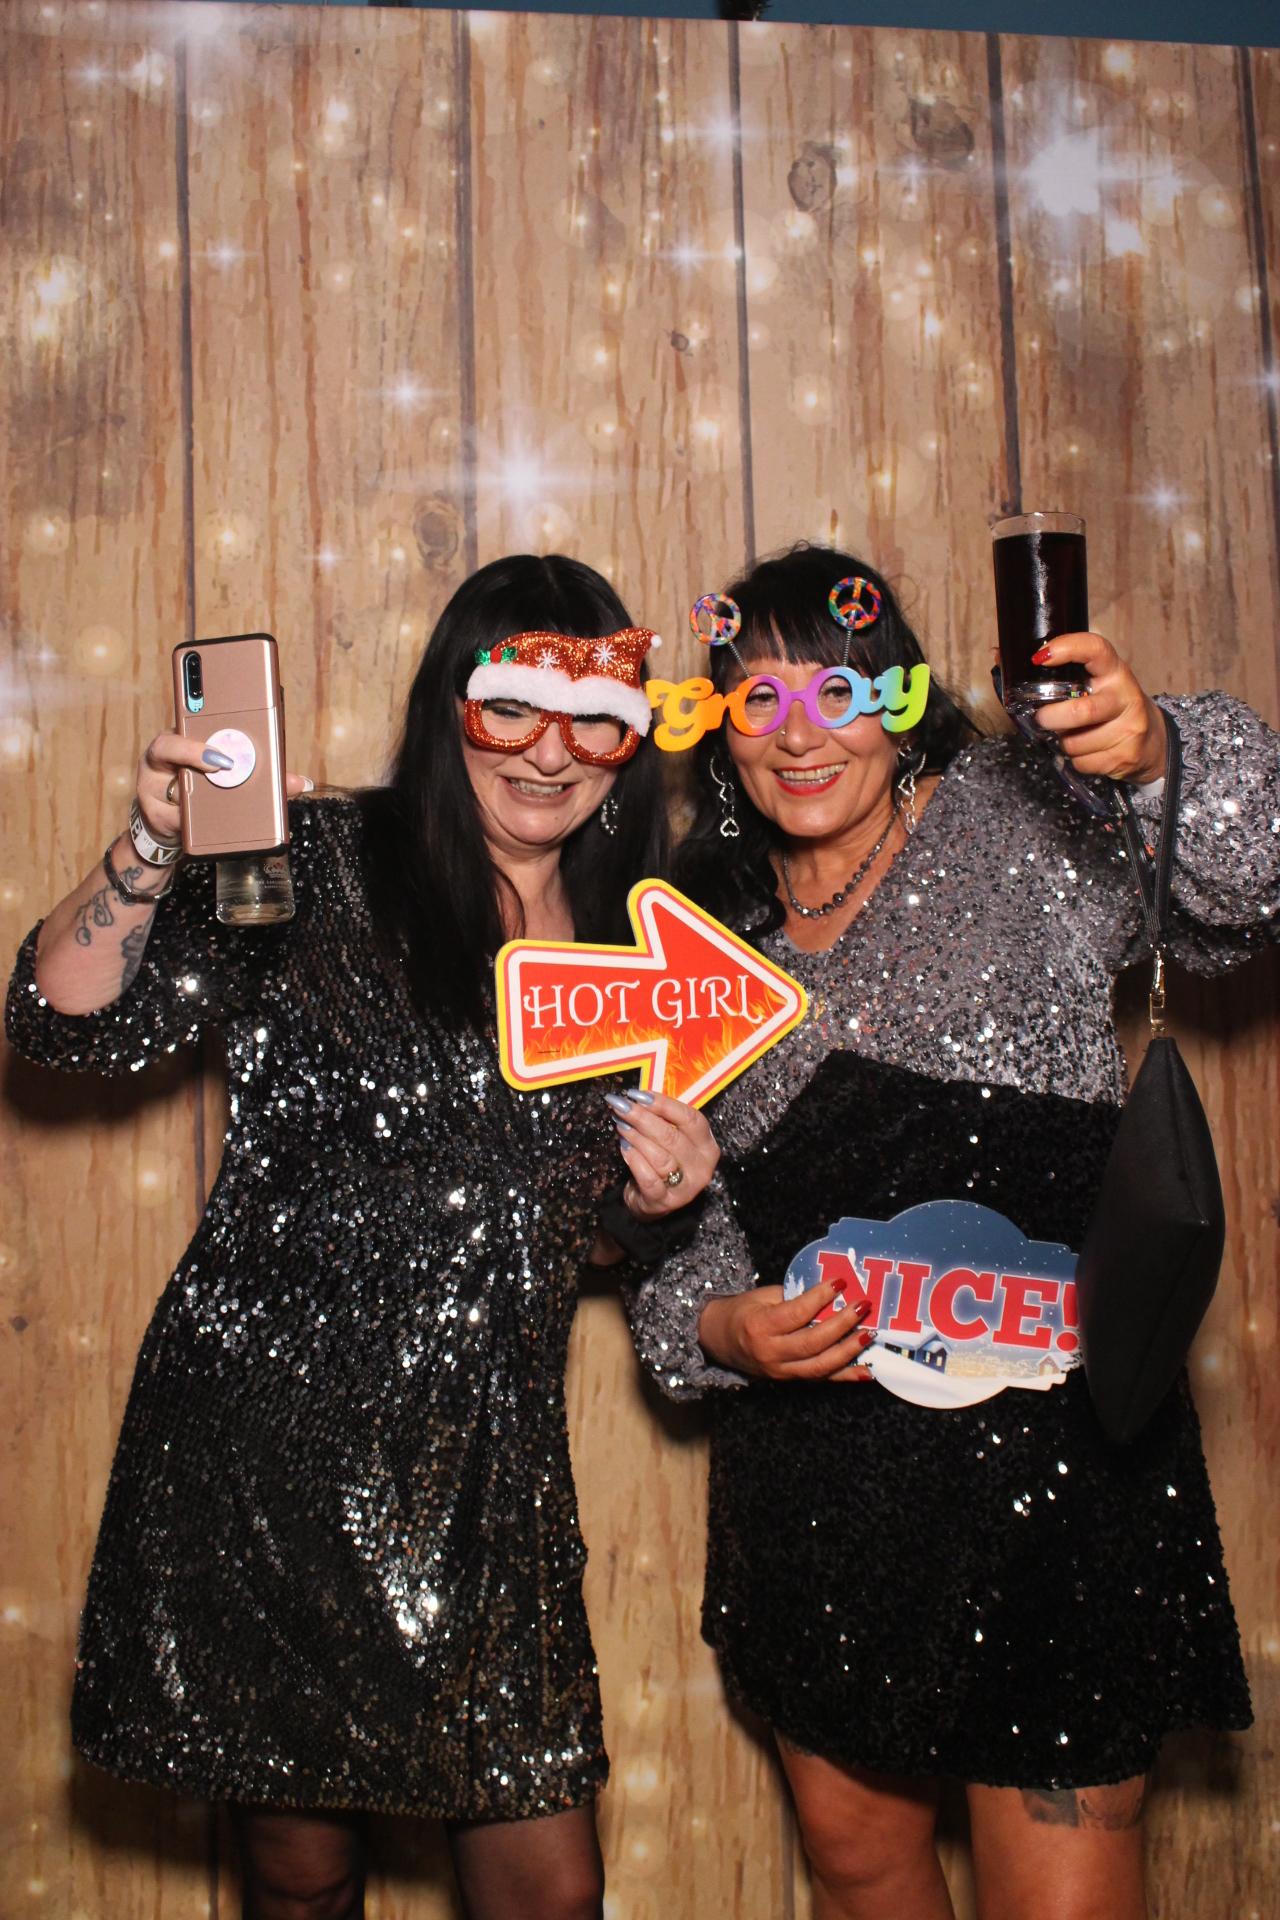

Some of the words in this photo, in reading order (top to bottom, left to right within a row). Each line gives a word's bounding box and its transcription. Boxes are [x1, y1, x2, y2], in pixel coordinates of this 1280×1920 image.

[523, 979, 641, 1029] HOT
[651, 975, 764, 1029] GIRL
[812, 1250, 1080, 1353] NICE!
